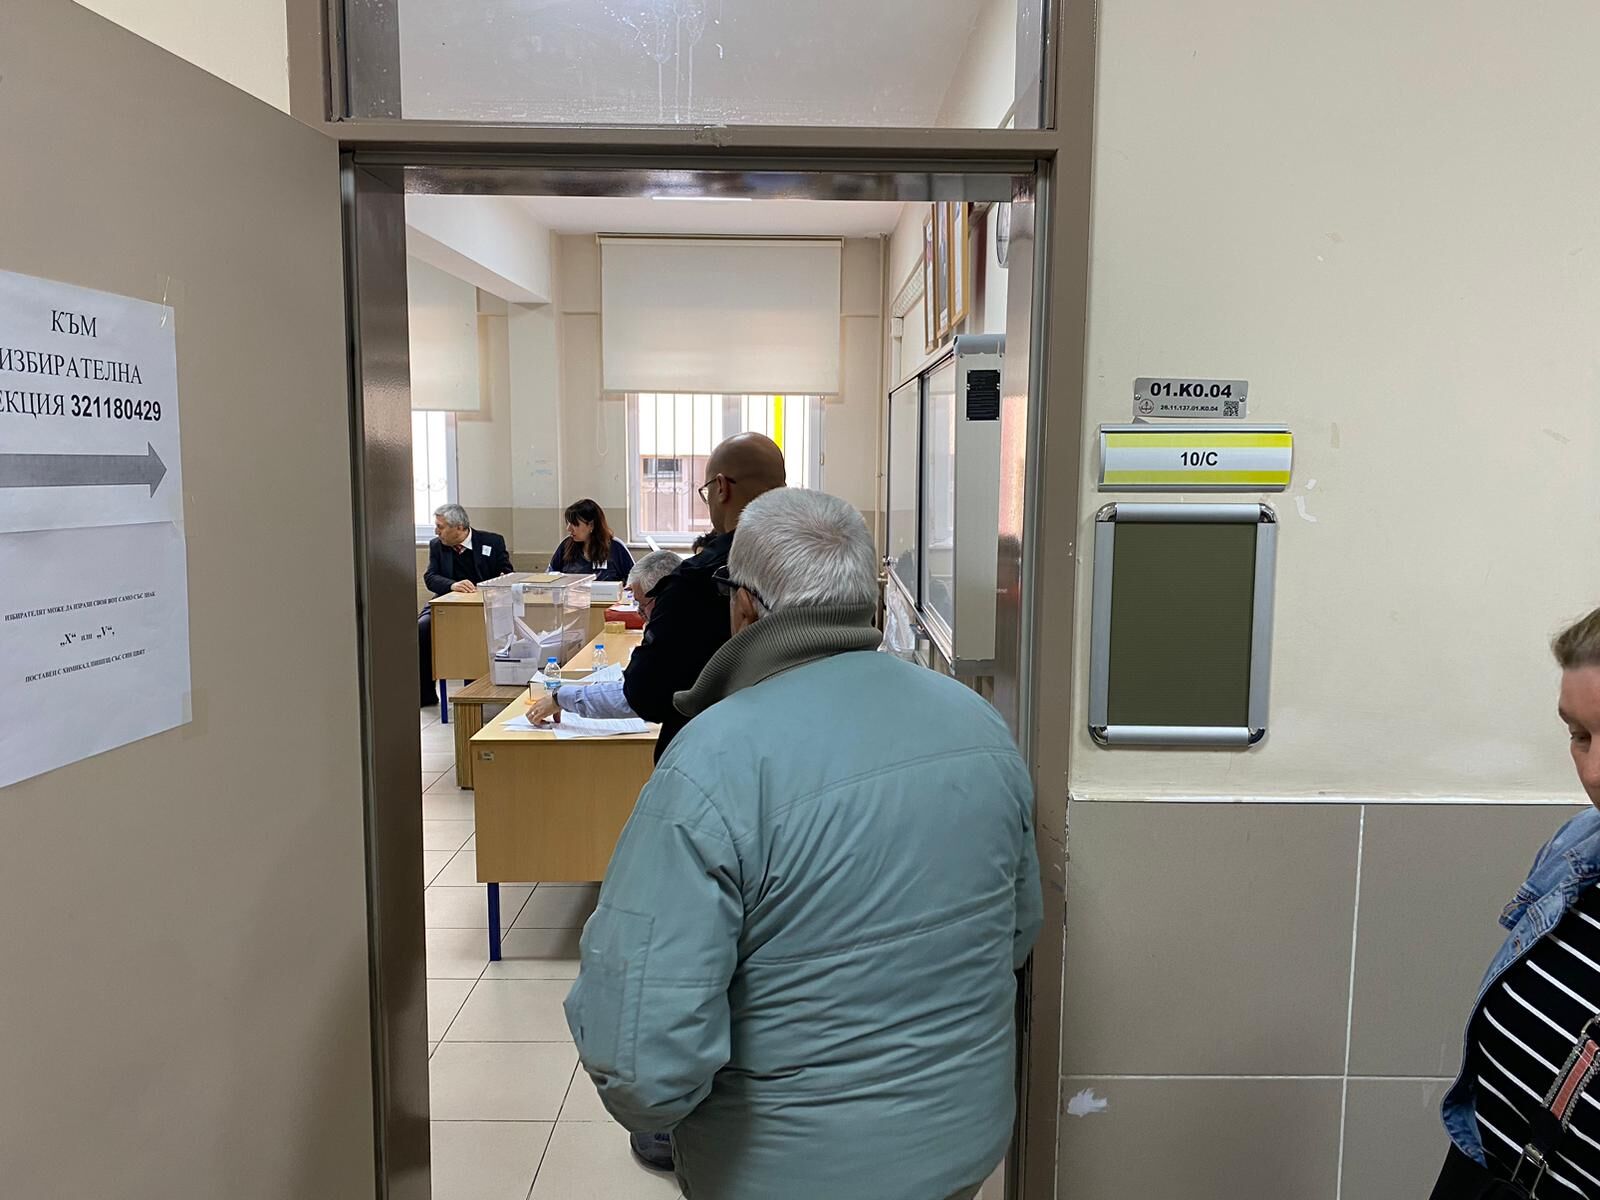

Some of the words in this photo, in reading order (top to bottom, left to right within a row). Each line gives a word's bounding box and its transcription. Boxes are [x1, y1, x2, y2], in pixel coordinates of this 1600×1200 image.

[51, 309, 97, 338] КЪМ
[0, 347, 143, 385] ИЗБИРАТЕЛНА
[1150, 382, 1232, 398] 01.K0.04
[71, 394, 161, 421] 321180429
[1180, 451, 1218, 466] 10/C
